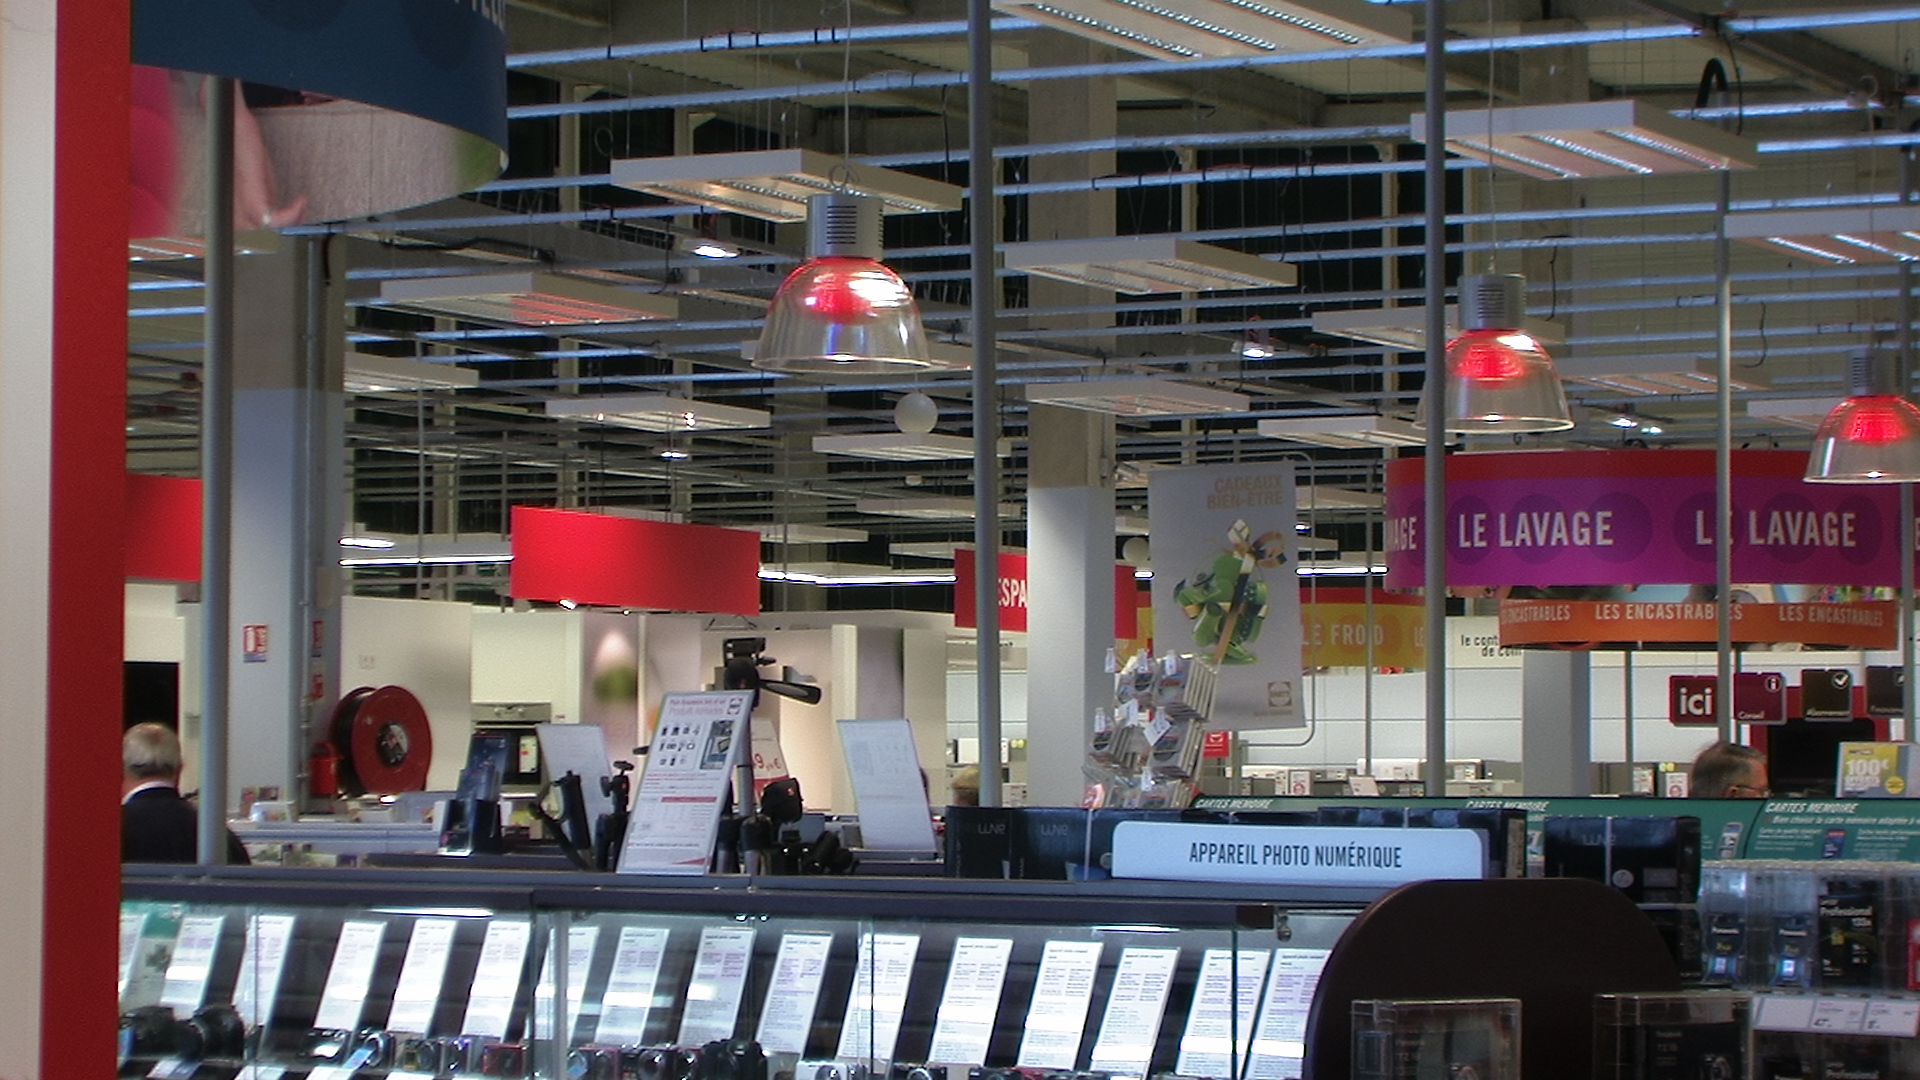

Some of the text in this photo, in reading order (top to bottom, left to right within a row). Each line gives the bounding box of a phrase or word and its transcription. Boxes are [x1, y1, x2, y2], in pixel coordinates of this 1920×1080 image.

[1214, 475, 1283, 493] CADEAUX
[1458, 511, 1614, 548] LE LAVAGE
[1749, 510, 1857, 548] LAVAGE
[1594, 603, 1620, 621] LES
[1779, 605, 1883, 627] LES ENCASTRABLES
[1331, 624, 1384, 646] FROD
[1461, 634, 1471, 646] le
[1680, 687, 1712, 716] ici
[1195, 799, 1231, 809] CARTES
[1765, 802, 1860, 815] CARTES MEMOIRE
[1189, 842, 1402, 868] APPAREIL PHOTO NUMÉRIQUE
